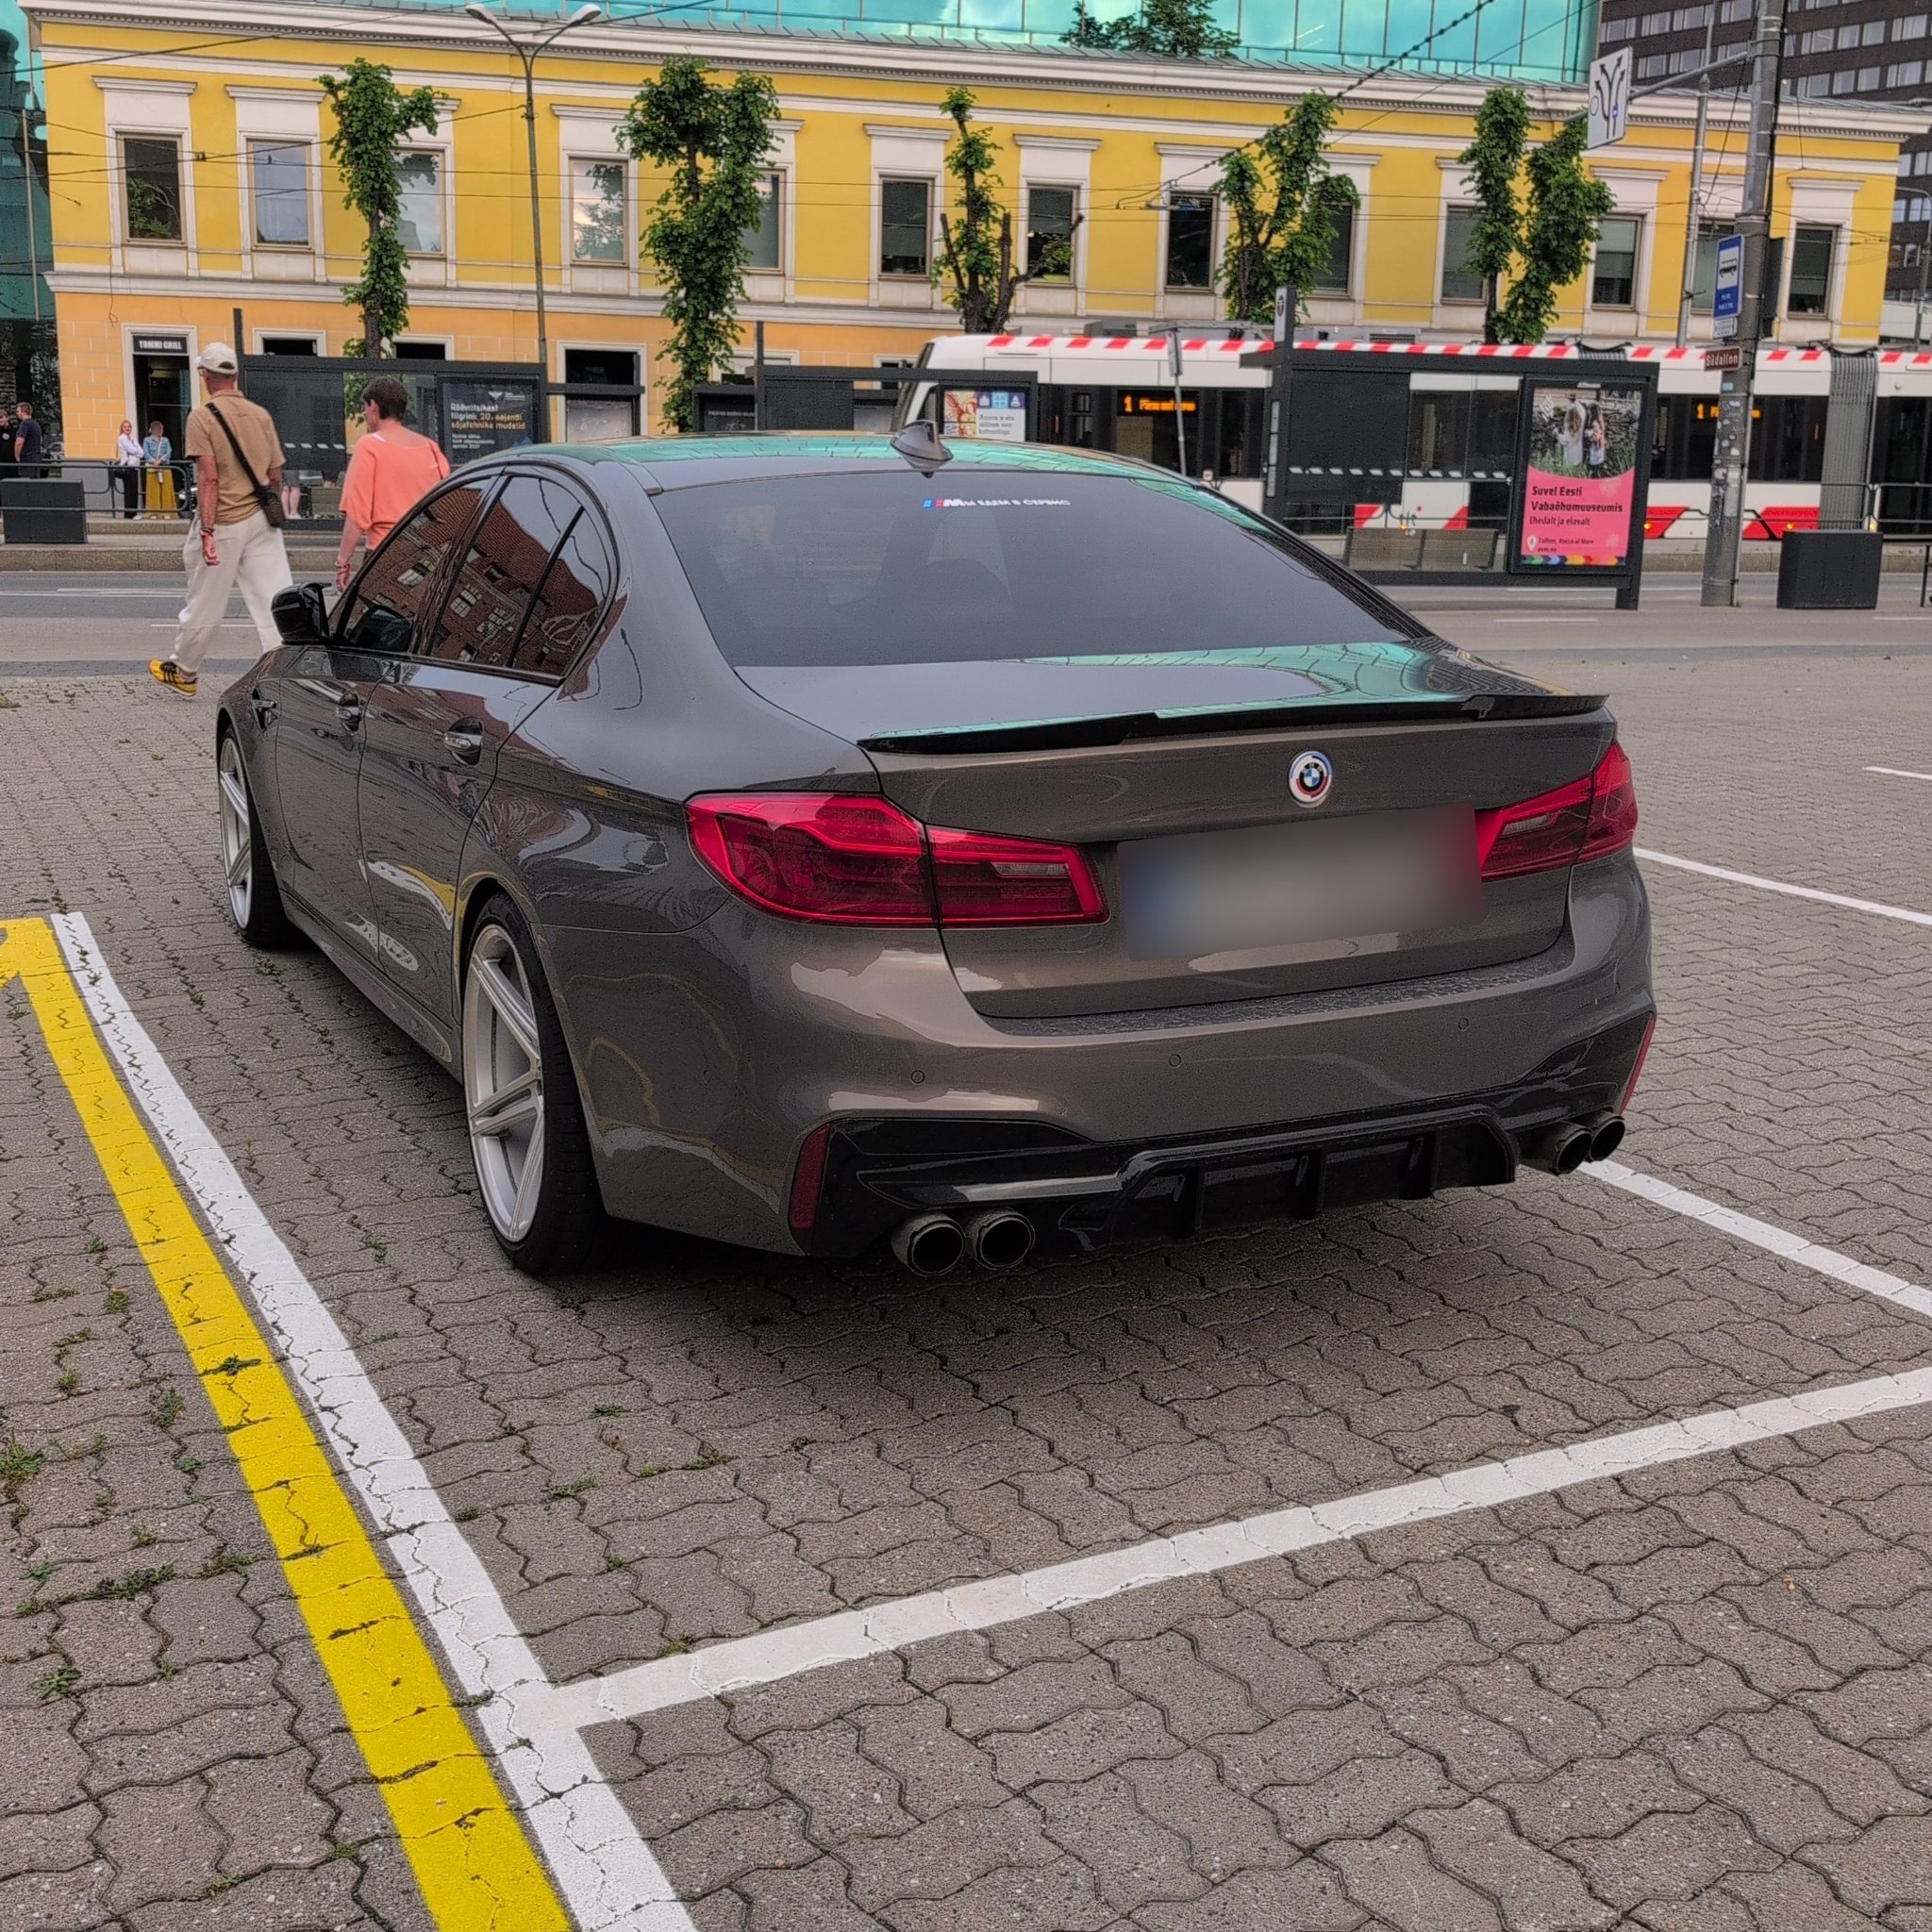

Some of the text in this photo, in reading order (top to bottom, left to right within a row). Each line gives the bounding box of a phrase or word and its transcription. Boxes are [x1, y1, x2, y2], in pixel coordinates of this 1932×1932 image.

[163, 341, 182, 350] GRILL
[1706, 353, 1738, 367] Südalinn
[1124, 395, 1132, 412] 1
[1532, 486, 1582, 496] Suvel Eesti
[1531, 501, 1623, 512] Vabaõhumuuseumis
[1529, 516, 1591, 527] Ehedalt ja elavalt
